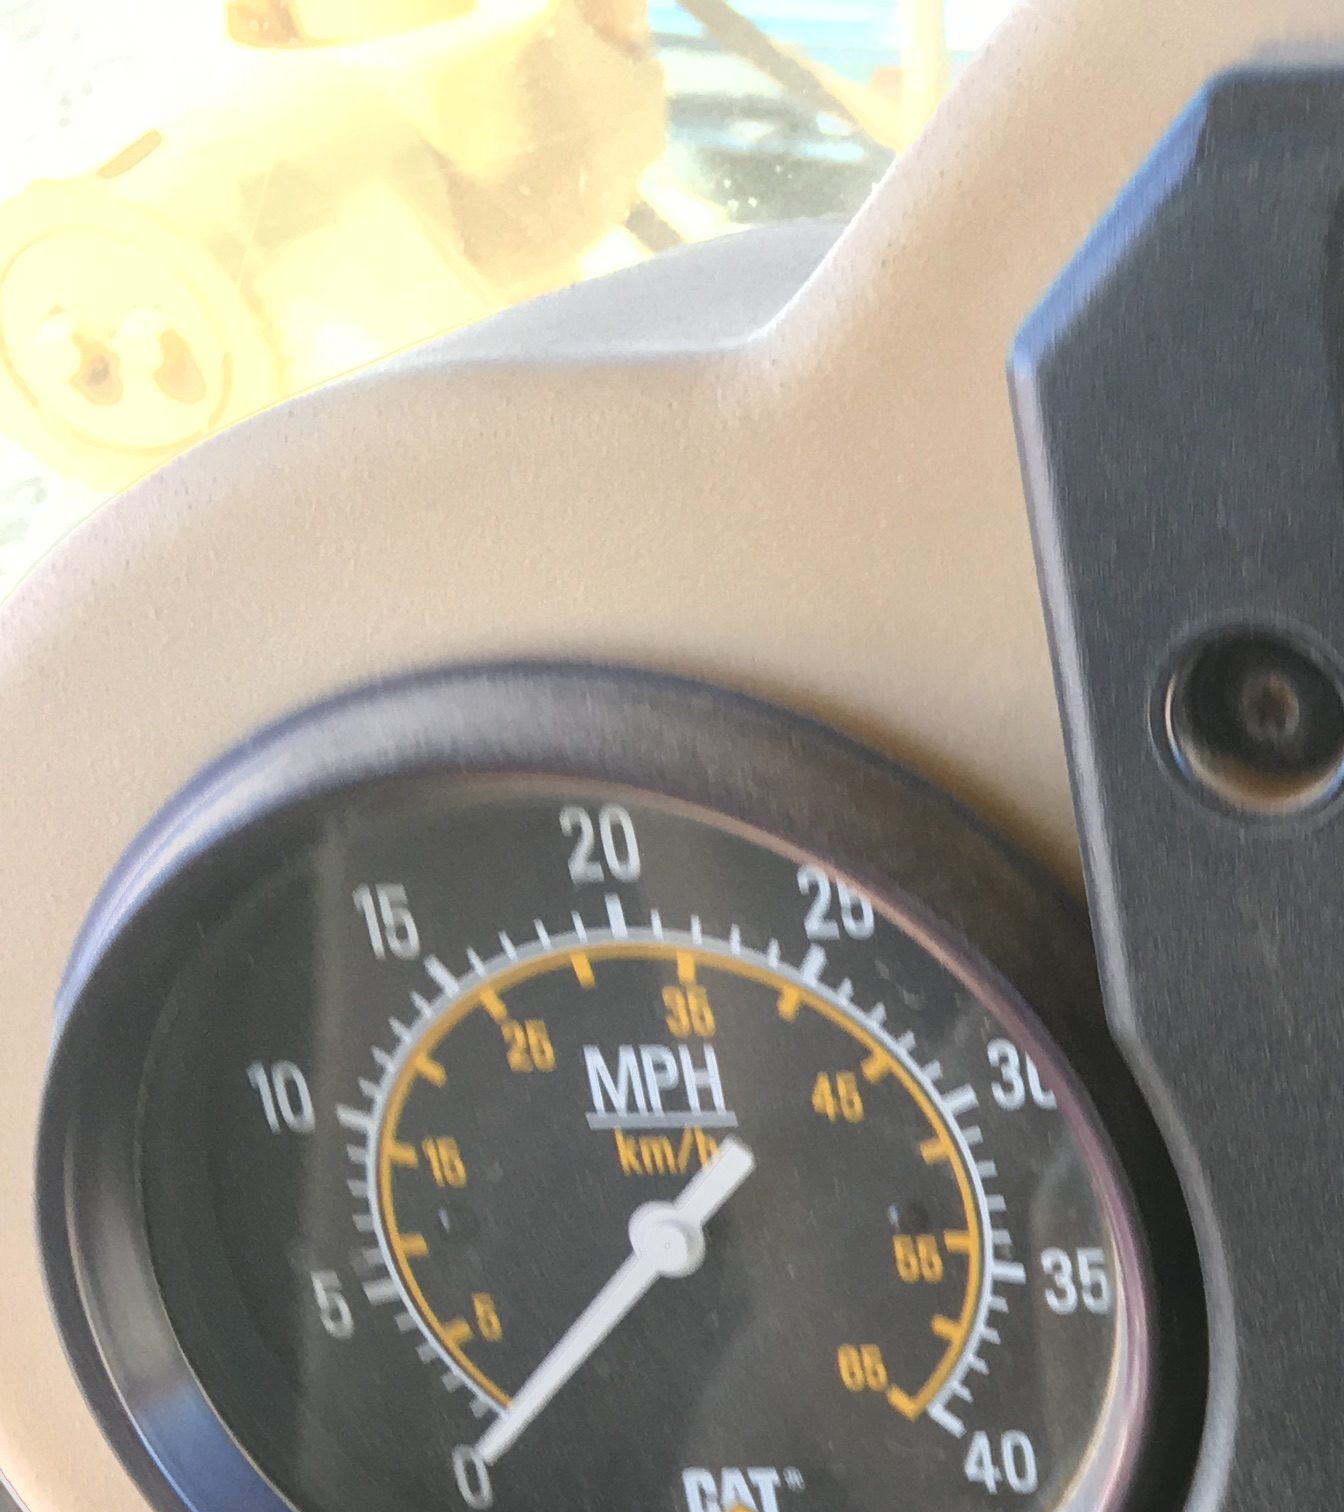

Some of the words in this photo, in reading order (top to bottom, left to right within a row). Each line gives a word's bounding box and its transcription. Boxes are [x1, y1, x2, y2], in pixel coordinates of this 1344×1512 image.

[559, 808, 640, 881] 20
[353, 885, 419, 959] 15
[797, 865, 875, 939] 25
[662, 986, 716, 1038] 35
[501, 1022, 557, 1072] 25
[248, 1061, 316, 1133] 10
[584, 1043, 728, 1118] MPH
[811, 1070, 865, 1123] 45
[428, 1138, 467, 1187] 15
[893, 1233, 944, 1283] 55
[1041, 1249, 1111, 1314] 35
[311, 1273, 353, 1338] 5
[475, 1293, 502, 1341] 5
[453, 1450, 493, 1508] 0
[963, 1433, 1038, 1493] 40
